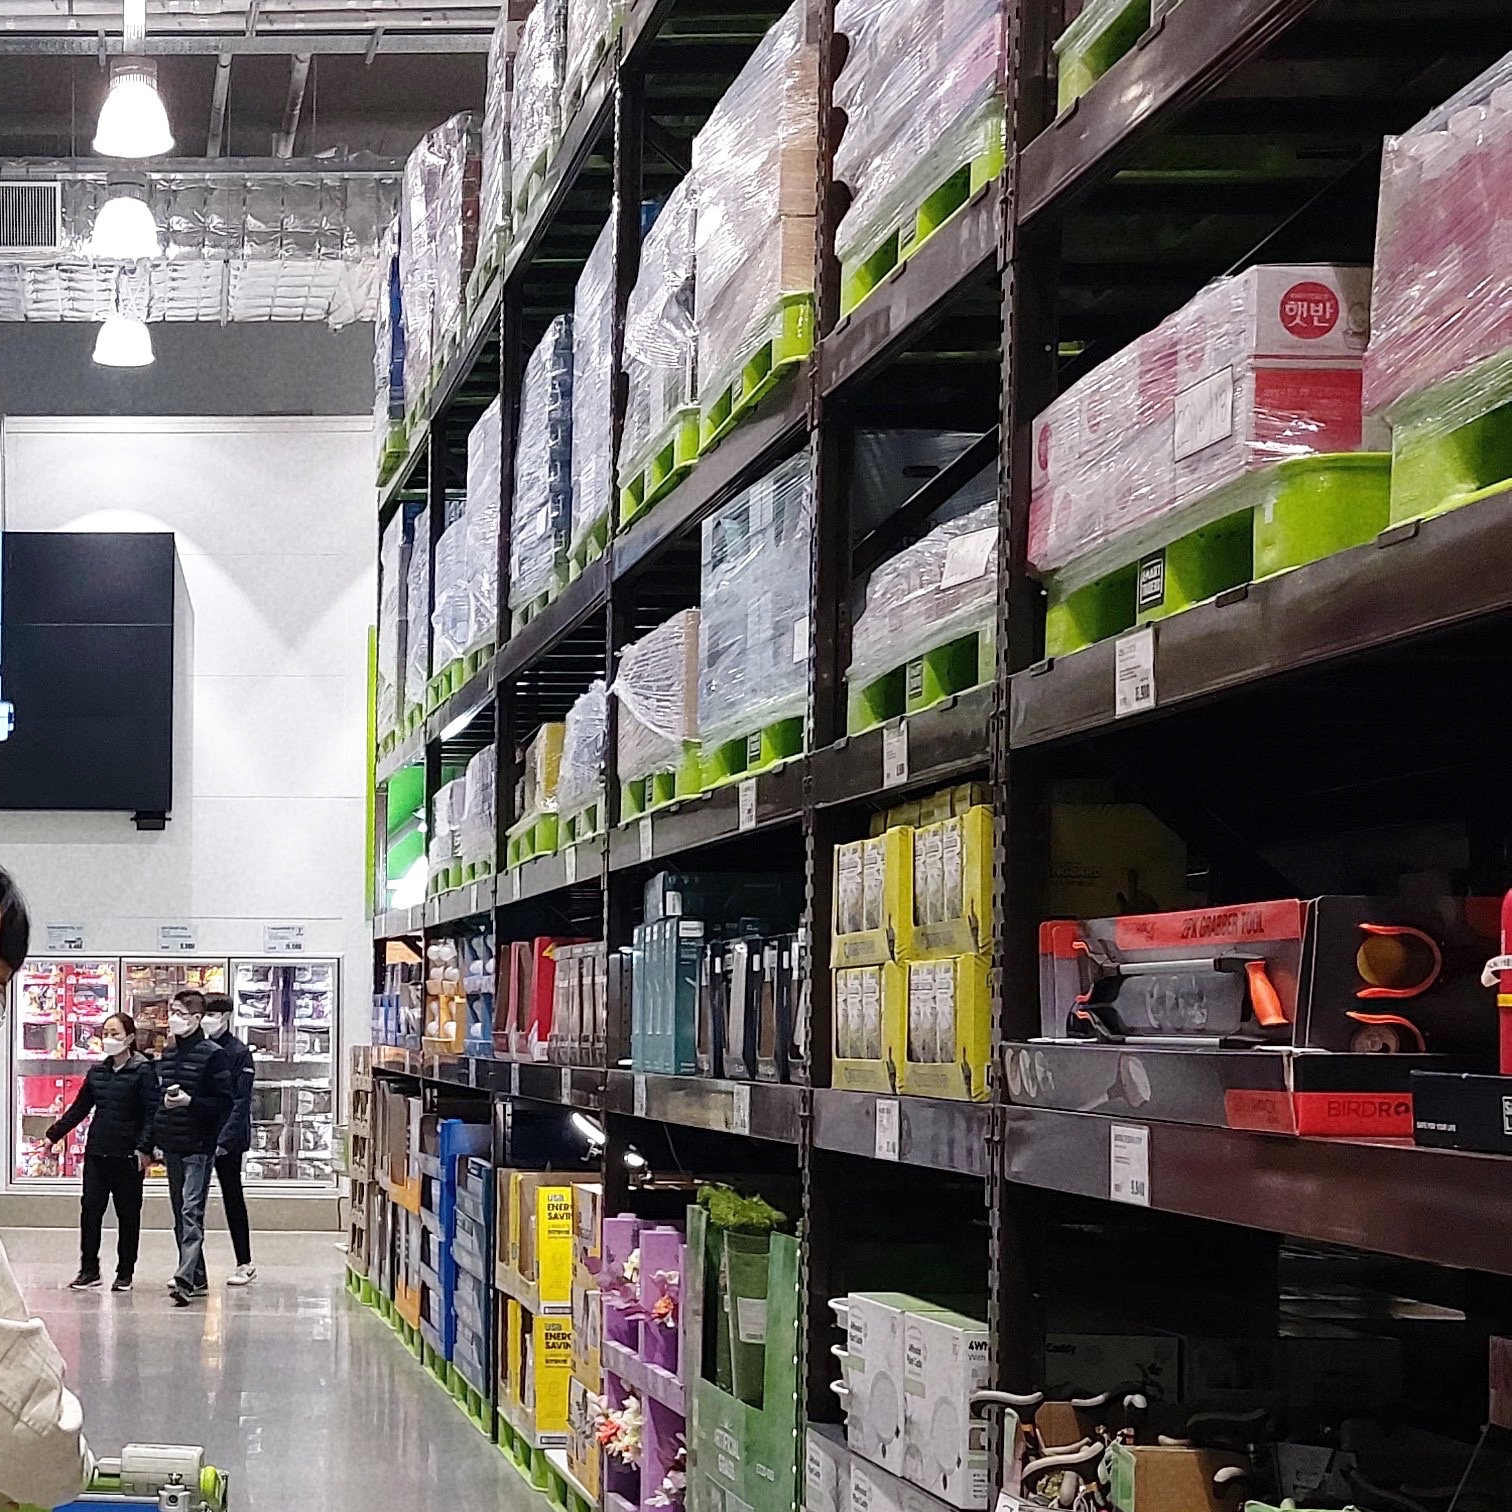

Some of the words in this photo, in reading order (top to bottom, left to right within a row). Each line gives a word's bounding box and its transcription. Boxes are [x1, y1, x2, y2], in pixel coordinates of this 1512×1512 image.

[1285, 299, 1335, 329] 햇반
[1200, 913, 1239, 938] GRABBER
[1240, 910, 1265, 934] TOOL
